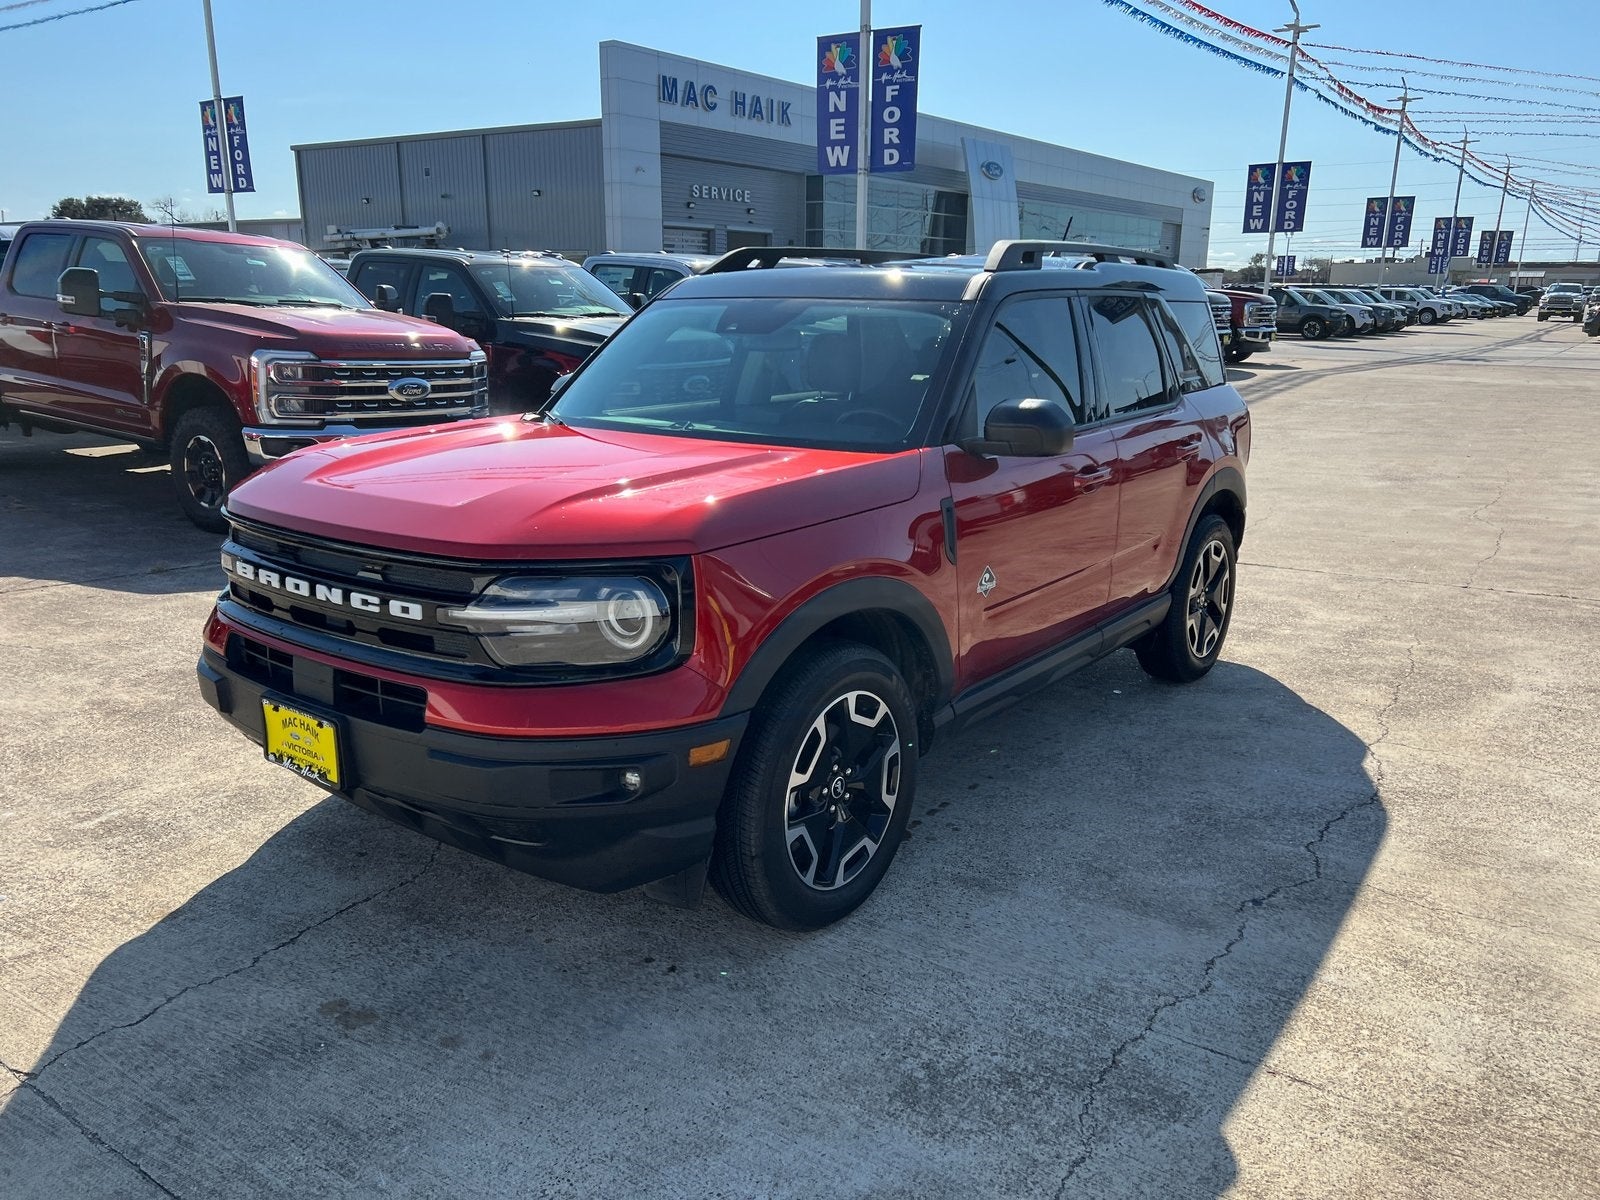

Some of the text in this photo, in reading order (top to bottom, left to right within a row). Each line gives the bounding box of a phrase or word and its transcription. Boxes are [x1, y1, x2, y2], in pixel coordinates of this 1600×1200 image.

[661, 74, 792, 125] MAC HAIK
[826, 91, 850, 167] NEW
[883, 85, 900, 166] FORD
[208, 137, 223, 188] NEW
[233, 136, 247, 188] FORD
[692, 184, 751, 203] SERVICE
[1249, 191, 1264, 230] NEW
[1283, 190, 1298, 230] FORD
[1366, 217, 1379, 246] NEW
[1393, 216, 1405, 246] FORD
[1434, 233, 1445, 255] NEW
[1456, 232, 1466, 255] FORD
[1480, 243, 1490, 262] NEW
[1498, 243, 1507, 262] FORD
[402, 384, 422, 396] Ford
[235, 560, 423, 621] BRONCO
[281, 717, 299, 731] MAC
[299, 719, 320, 744] HAIK
[286, 742, 319, 761] VICTORIA
